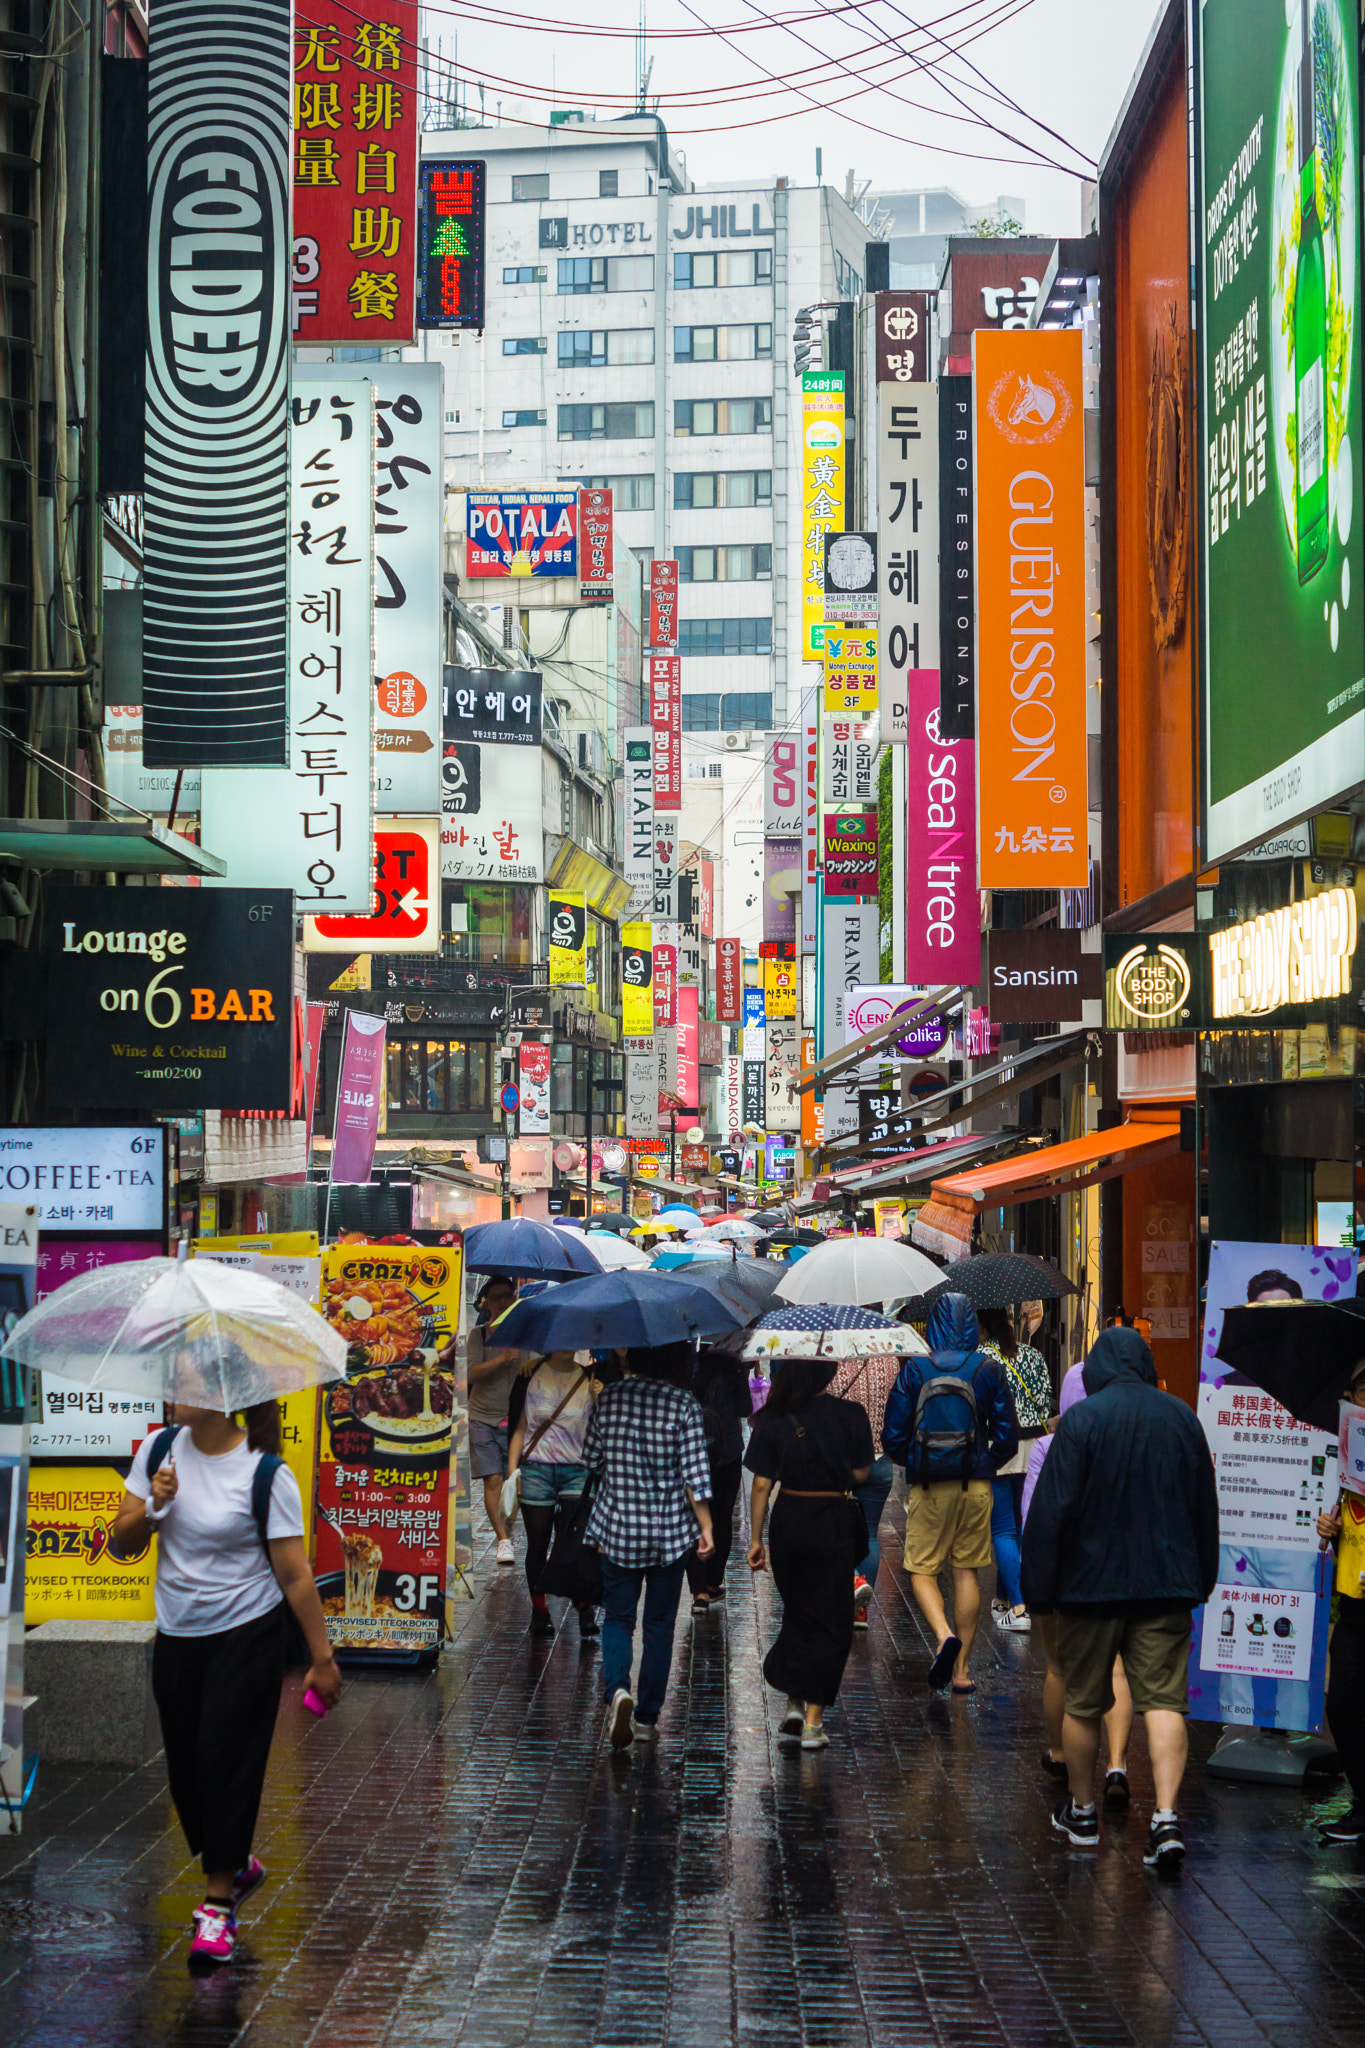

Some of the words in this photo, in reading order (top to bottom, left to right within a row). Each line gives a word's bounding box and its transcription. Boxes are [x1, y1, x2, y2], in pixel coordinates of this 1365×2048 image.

[294, 25, 342, 187] 无限量
[349, 23, 402, 320] 猪排自助餐
[673, 203, 775, 239] JHILL
[1207, 180, 1228, 244] DROPS
[573, 223, 652, 245] HOTEL
[170, 151, 264, 392] FOLDER
[529, 494, 554, 504] NEPALI
[555, 494, 574, 503] FOOD
[470, 508, 574, 538] POTALA
[471, 551, 499, 563] 포탈라
[544, 550, 572, 562] 명동점
[955, 402, 968, 713] PROFESSIONAL
[828, 662, 846, 671] Money
[848, 662, 875, 671] Exchange
[672, 661, 680, 697] TIBETAN
[828, 674, 876, 690] 상품권
[653, 660, 671, 721] 포탈라
[843, 696, 860, 707] 3F
[653, 730, 670, 793] 명동점
[672, 739, 680, 768] NEPALI
[672, 770, 680, 793] FOOD
[832, 744, 848, 799] 시계수리
[856, 744, 872, 798] 오리엔트
[633, 768, 652, 859] RIAHN
[655, 823, 674, 836] 수원
[994, 826, 1075, 854] 九朵云
[826, 838, 876, 854] Waxing
[826, 858, 878, 874] ワックシング
[654, 840, 674, 916] 왕갈비
[248, 905, 273, 922] 6F
[63, 922, 187, 962] Lounge
[844, 916, 861, 991] FRANC
[994, 966, 1078, 986] Sansim
[1140, 967, 1166, 977] THE
[653, 951, 672, 1019] 부대찌개
[1131, 979, 1177, 991] BODY
[190, 988, 275, 1022] BAR
[1134, 992, 1175, 1004] SHOP
[629, 1039, 654, 1050] 부동산
[898, 1028, 942, 1043] olika
[111, 1044, 148, 1058] Wine
[152, 1046, 166, 1058] &
[169, 1045, 226, 1059] Cocktail
[136, 1067, 201, 1079] ~am02:00
[747, 1072, 759, 1107] 돈까스
[728, 1058, 739, 1154] PANDAKOA
[131, 1136, 156, 1154] 6F
[0, 1164, 155, 1190] OFFEE·TEA
[46, 1206, 75, 1220] 소바
[86, 1205, 113, 1220] 카레
[0, 1225, 31, 1246] EA
[1145, 1246, 1187, 1263] SALE
[343, 1259, 420, 1285] CRAZY
[108, 1402, 155, 1414] 명동센터
[1217, 1411, 1326, 1433] 国庆长假专享活
[334, 1465, 370, 1487] 즐거운
[373, 1468, 438, 1491] 런치타임
[407, 1494, 431, 1504] 3:00
[328, 1507, 442, 1530] 치즈날치알볶음밥
[397, 1529, 441, 1550] 서비스
[71, 1575, 150, 1586] TTEOKBOKKI
[394, 1573, 439, 1611] 3F
[1262, 1593, 1287, 1606] HOT
[1289, 1596, 1301, 1608] 3!
[323, 1616, 378, 1627] MPROVISED
[379, 1618, 439, 1629] TTEOKBOKKI
[325, 1627, 384, 1641] 席トッポッキ
[1217, 1703, 1233, 1714] THE
[1234, 1705, 1256, 1716] BODY
